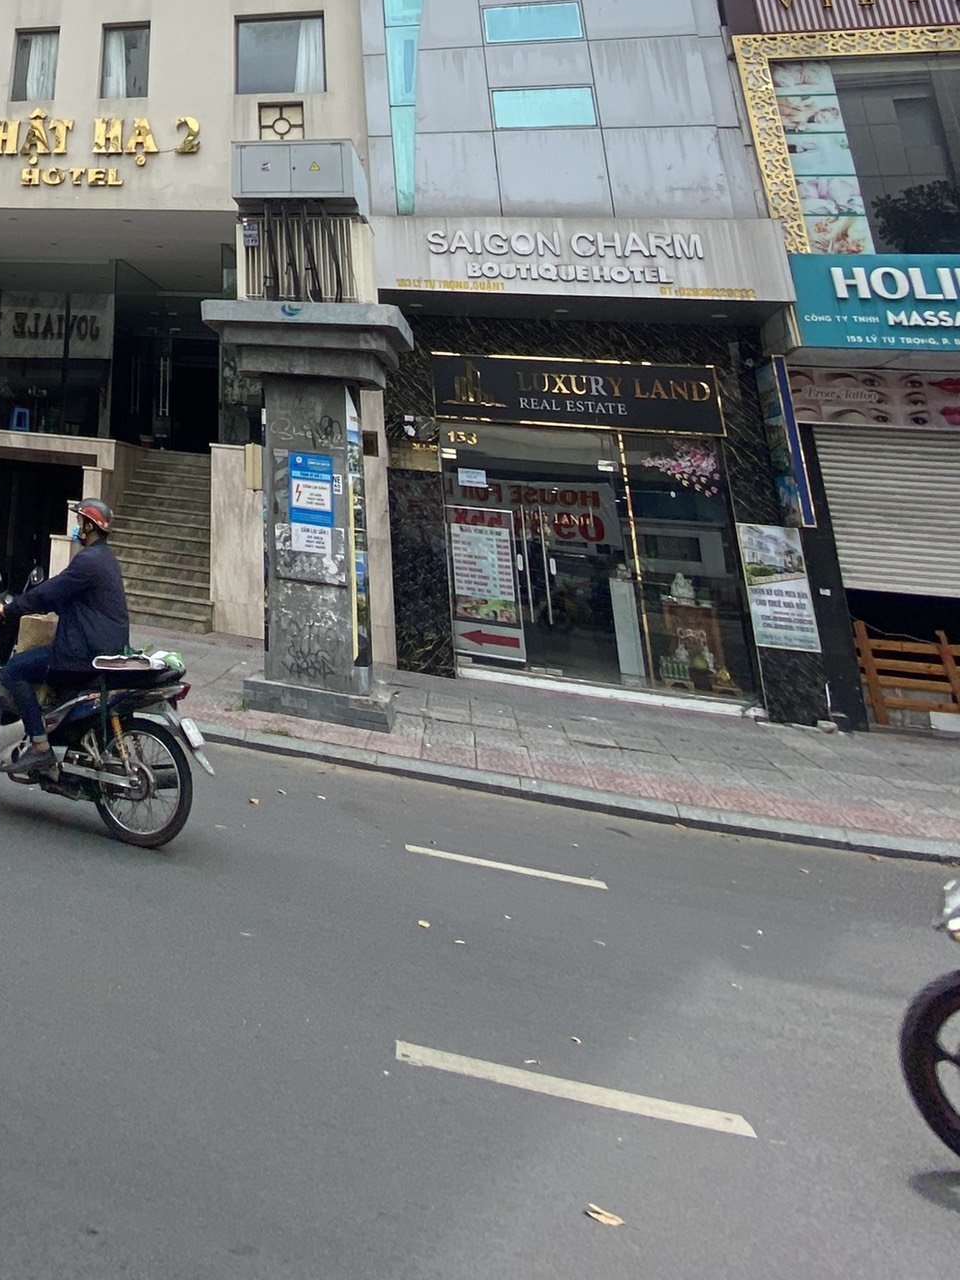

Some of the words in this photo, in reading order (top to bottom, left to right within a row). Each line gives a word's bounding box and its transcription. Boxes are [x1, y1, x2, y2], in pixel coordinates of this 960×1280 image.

[92, 116, 159, 168] HẠ
[174, 115, 201, 155] 2
[20, 167, 125, 186] HOTEL
[426, 229, 561, 257] SAIGON
[570, 231, 704, 260] CHARM
[516, 370, 623, 398] LUXURY
[633, 378, 712, 403] LAND
[519, 396, 566, 413] REAL
[566, 400, 628, 416] ESTATE
[447, 430, 478, 446] 153
